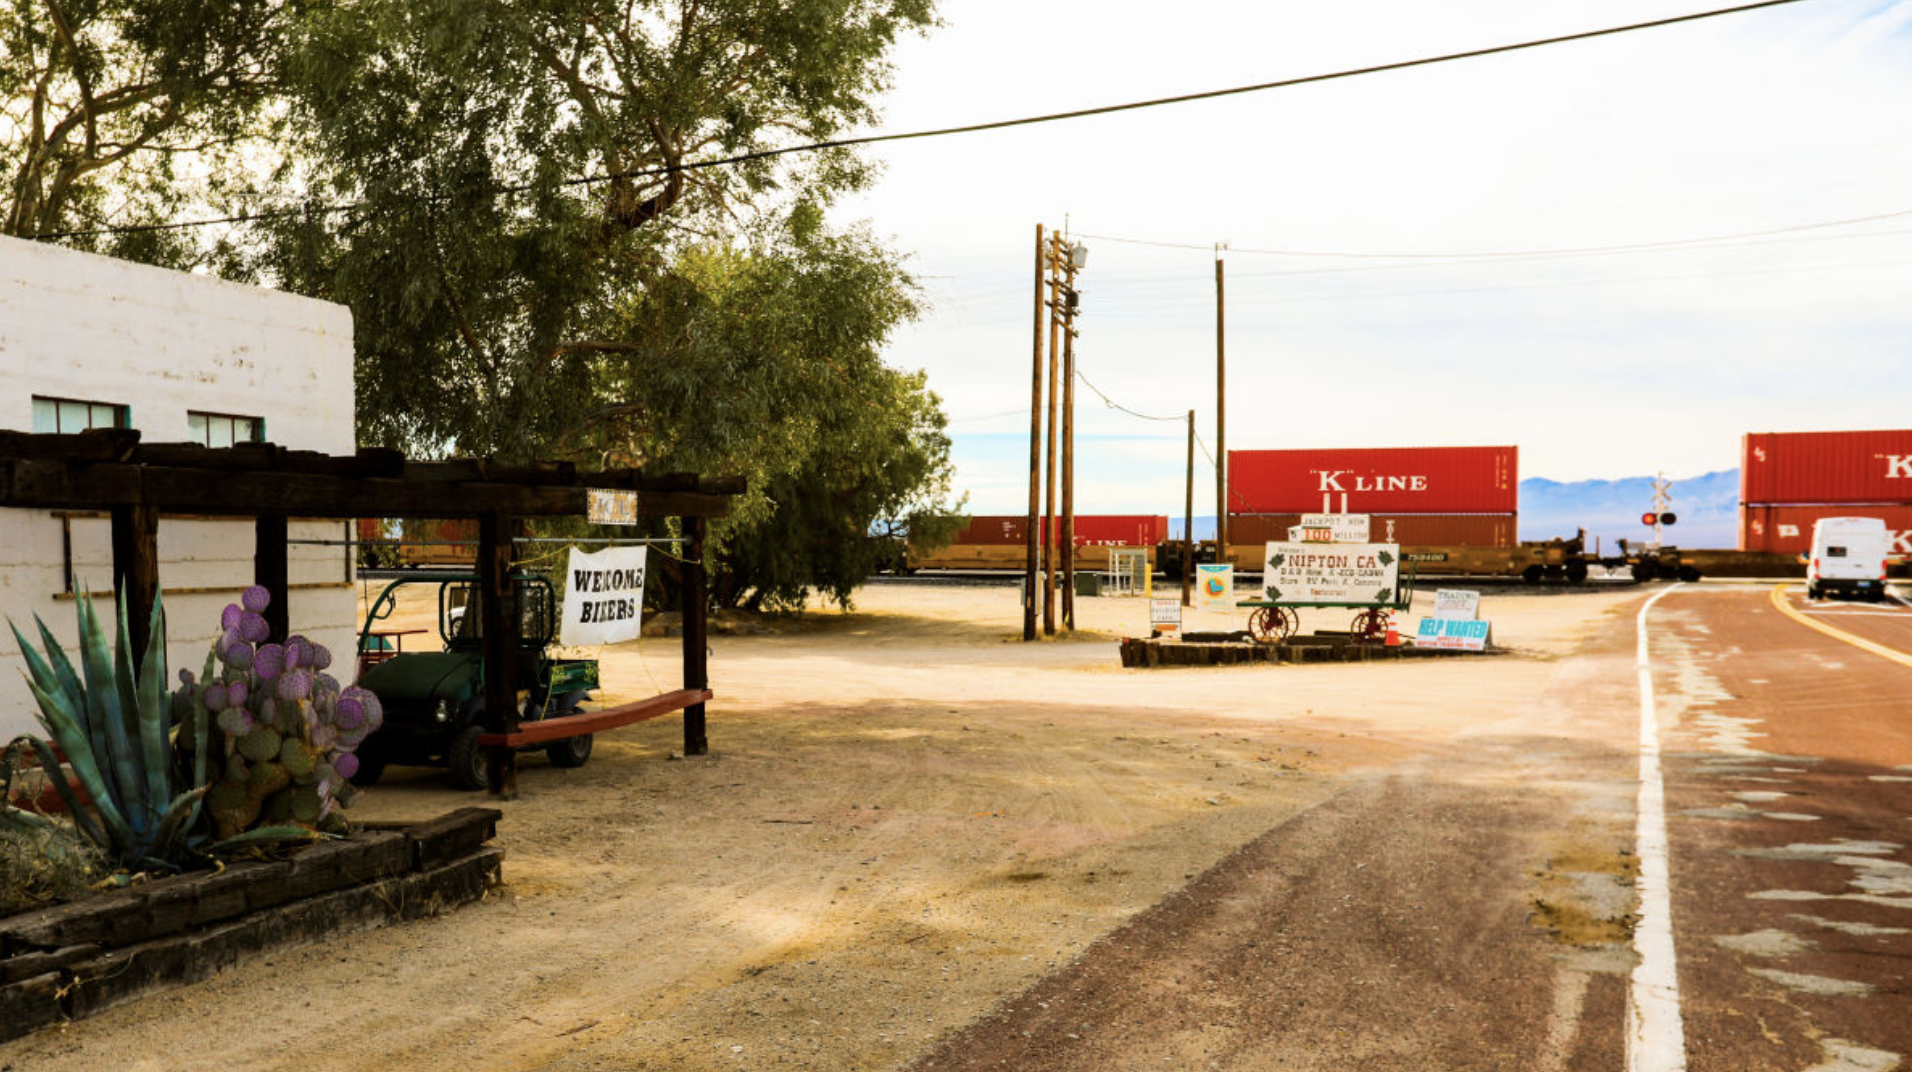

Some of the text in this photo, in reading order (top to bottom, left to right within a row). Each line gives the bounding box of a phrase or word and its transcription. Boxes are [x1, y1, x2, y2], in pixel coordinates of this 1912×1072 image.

[1355, 475, 1428, 491] LINE
[1305, 528, 1331, 541] 100
[1356, 555, 1376, 569] CA
[574, 568, 643, 592] WELCOME
[580, 598, 635, 623] BIKERS
[1418, 618, 1487, 638] HELP WANTED
